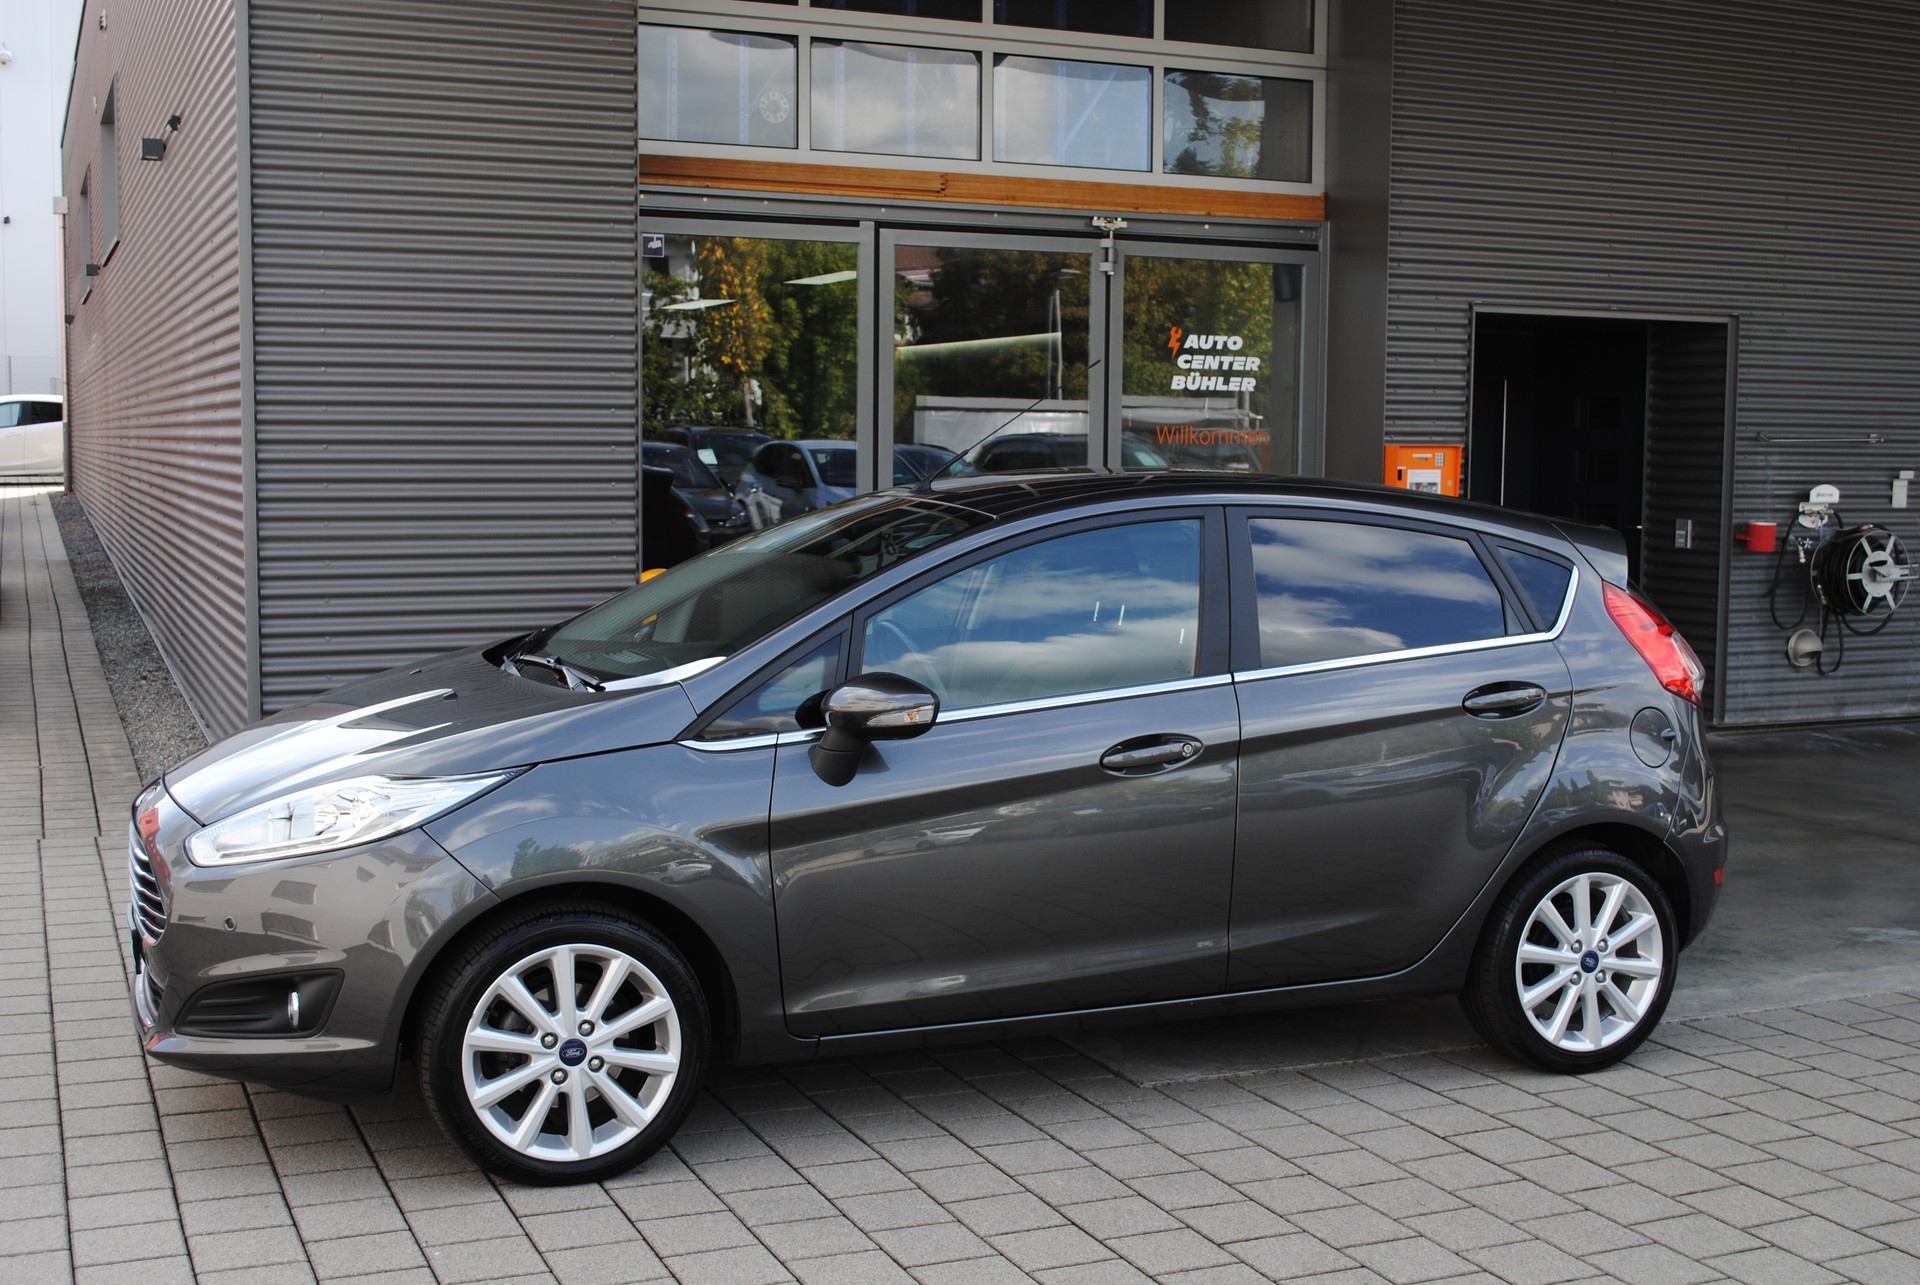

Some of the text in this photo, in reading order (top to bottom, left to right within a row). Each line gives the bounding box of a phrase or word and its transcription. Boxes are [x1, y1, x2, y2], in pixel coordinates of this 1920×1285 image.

[1183, 334, 1244, 351] AUTO
[1176, 354, 1261, 371] CENTER
[1170, 372, 1257, 392] BÜHLER
[1156, 425, 1270, 446] Willkommen
[564, 1048, 582, 1057] Ford
